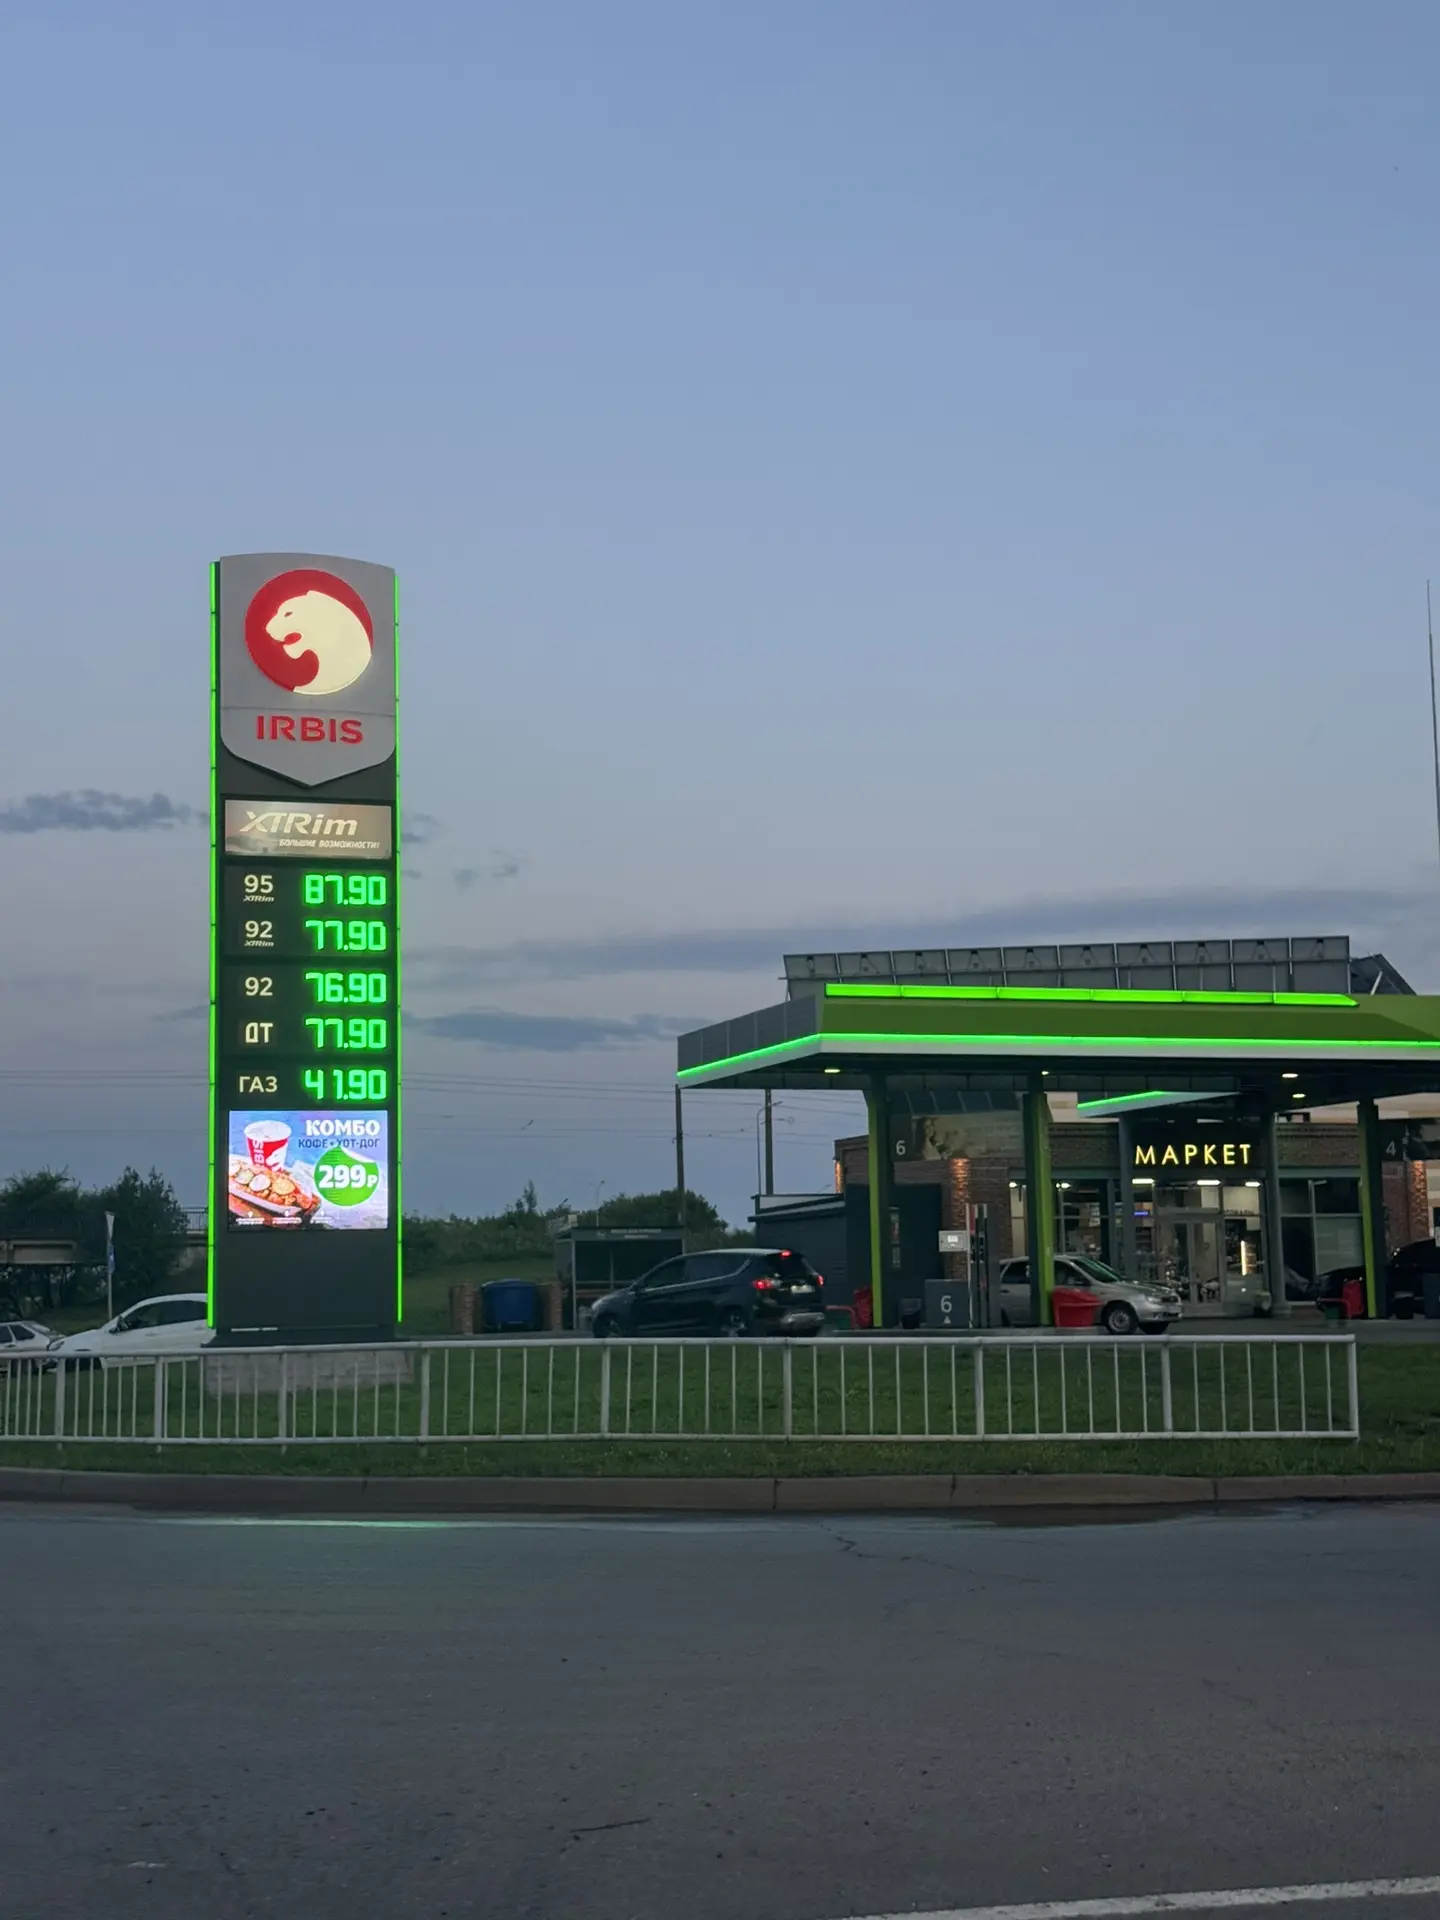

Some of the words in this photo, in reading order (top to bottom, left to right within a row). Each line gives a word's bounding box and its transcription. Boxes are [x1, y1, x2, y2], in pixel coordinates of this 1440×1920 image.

[256, 715, 363, 744] IRBIS
[240, 810, 358, 836] XTRim
[243, 874, 274, 893] 95
[305, 874, 387, 905] 87.90
[244, 920, 273, 938] 92
[305, 920, 387, 950] 77.90
[244, 976, 273, 996] 92
[305, 972, 387, 1003] 76.90
[245, 1022, 273, 1043] ДТ
[305, 1018, 387, 1049] 77.90
[238, 1076, 278, 1093] ГАЗ
[305, 1069, 387, 1100] 41.90
[305, 1119, 381, 1136] КОМБО
[298, 1138, 328, 1149] КОФЕ
[896, 1139, 906, 1155] 6
[1385, 1139, 1397, 1157] 4
[1134, 1144, 1252, 1165] МАРКЕТ
[940, 1295, 953, 1313] 6
